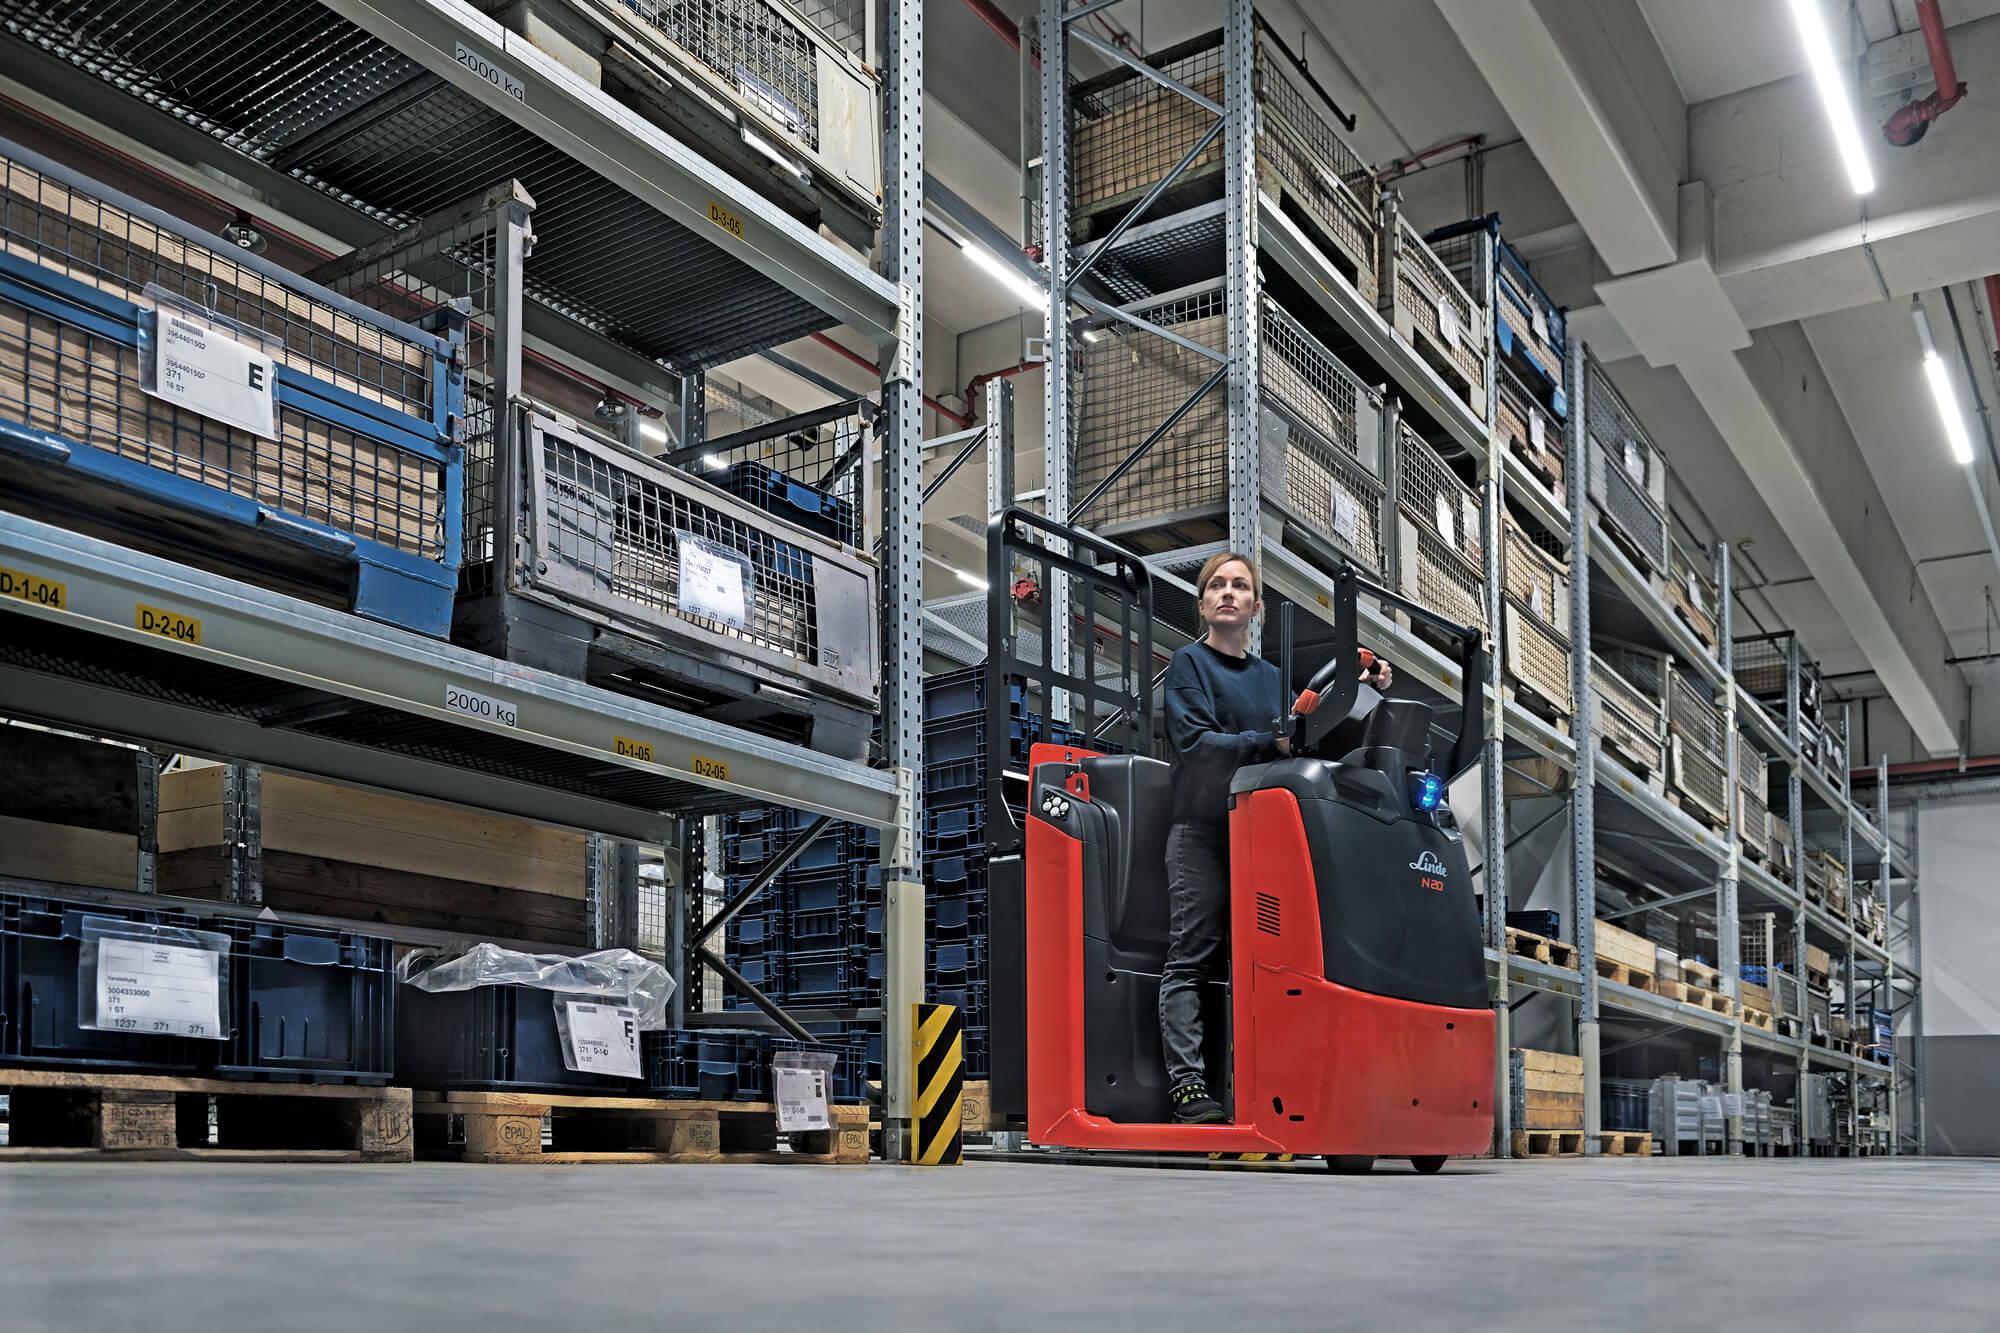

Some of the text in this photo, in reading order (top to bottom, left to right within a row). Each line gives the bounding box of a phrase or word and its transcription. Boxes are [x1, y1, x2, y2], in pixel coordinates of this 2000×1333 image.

[457, 48, 499, 85] 2000
[711, 206, 740, 235] D-3-05
[166, 367, 181, 381] 371
[248, 361, 264, 392] E
[166, 380, 185, 393] 16 ST
[0, 572, 60, 608] D-1-04
[142, 609, 196, 641] D-2-04
[688, 605, 736, 626] 1237 371 371
[447, 690, 515, 727] 2000 kg
[617, 740, 650, 762] D-1-05
[695, 759, 725, 780] D-2-05
[1409, 850, 1448, 877] Linde
[108, 996, 120, 1004] 371
[114, 1005, 125, 1013] ST
[115, 1019, 204, 1034] 1237 371 371
[504, 1125, 529, 1140] EPAL
